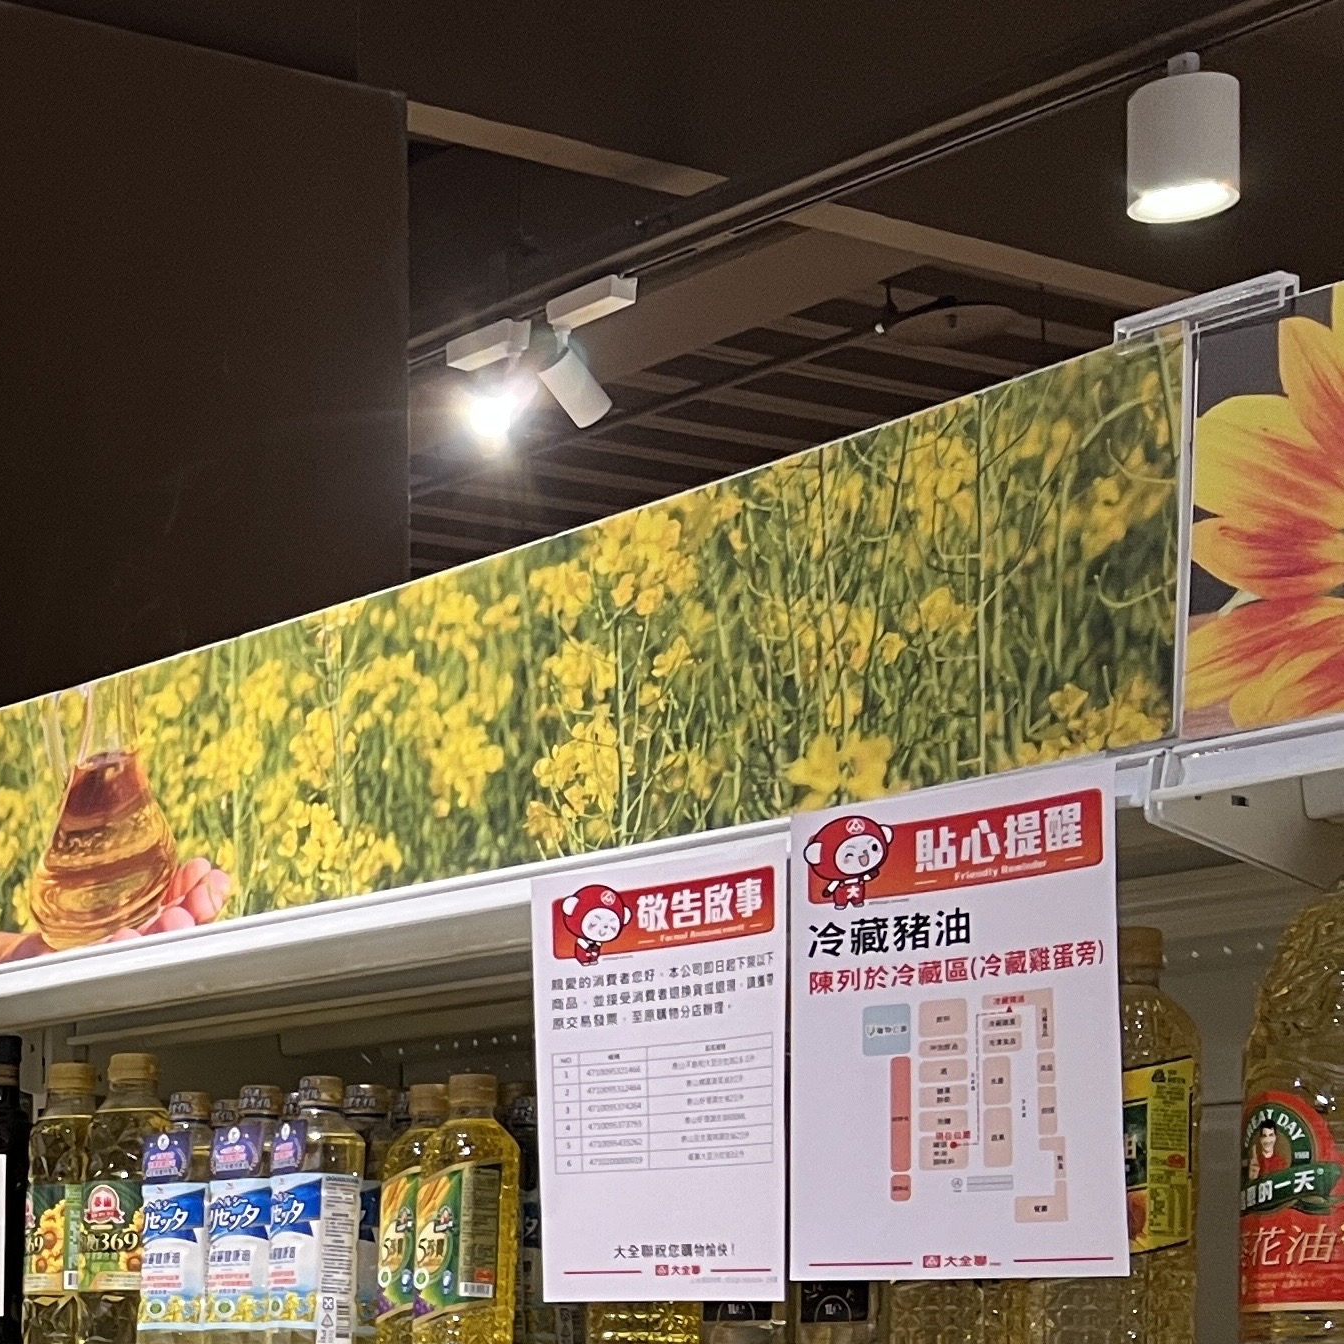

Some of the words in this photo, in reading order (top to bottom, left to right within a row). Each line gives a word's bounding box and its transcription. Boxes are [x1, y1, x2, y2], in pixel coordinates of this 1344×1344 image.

[915, 802, 1083, 873] 貼心提醒
[954, 865, 998, 882] Friendly
[636, 877, 764, 933] 敬告啟事
[807, 906, 972, 959] 冷藏豬油
[808, 938, 1106, 996] 陳列於冷藏區(冷藏雞蛋旁)
[1275, 1112, 1307, 1142] DAY
